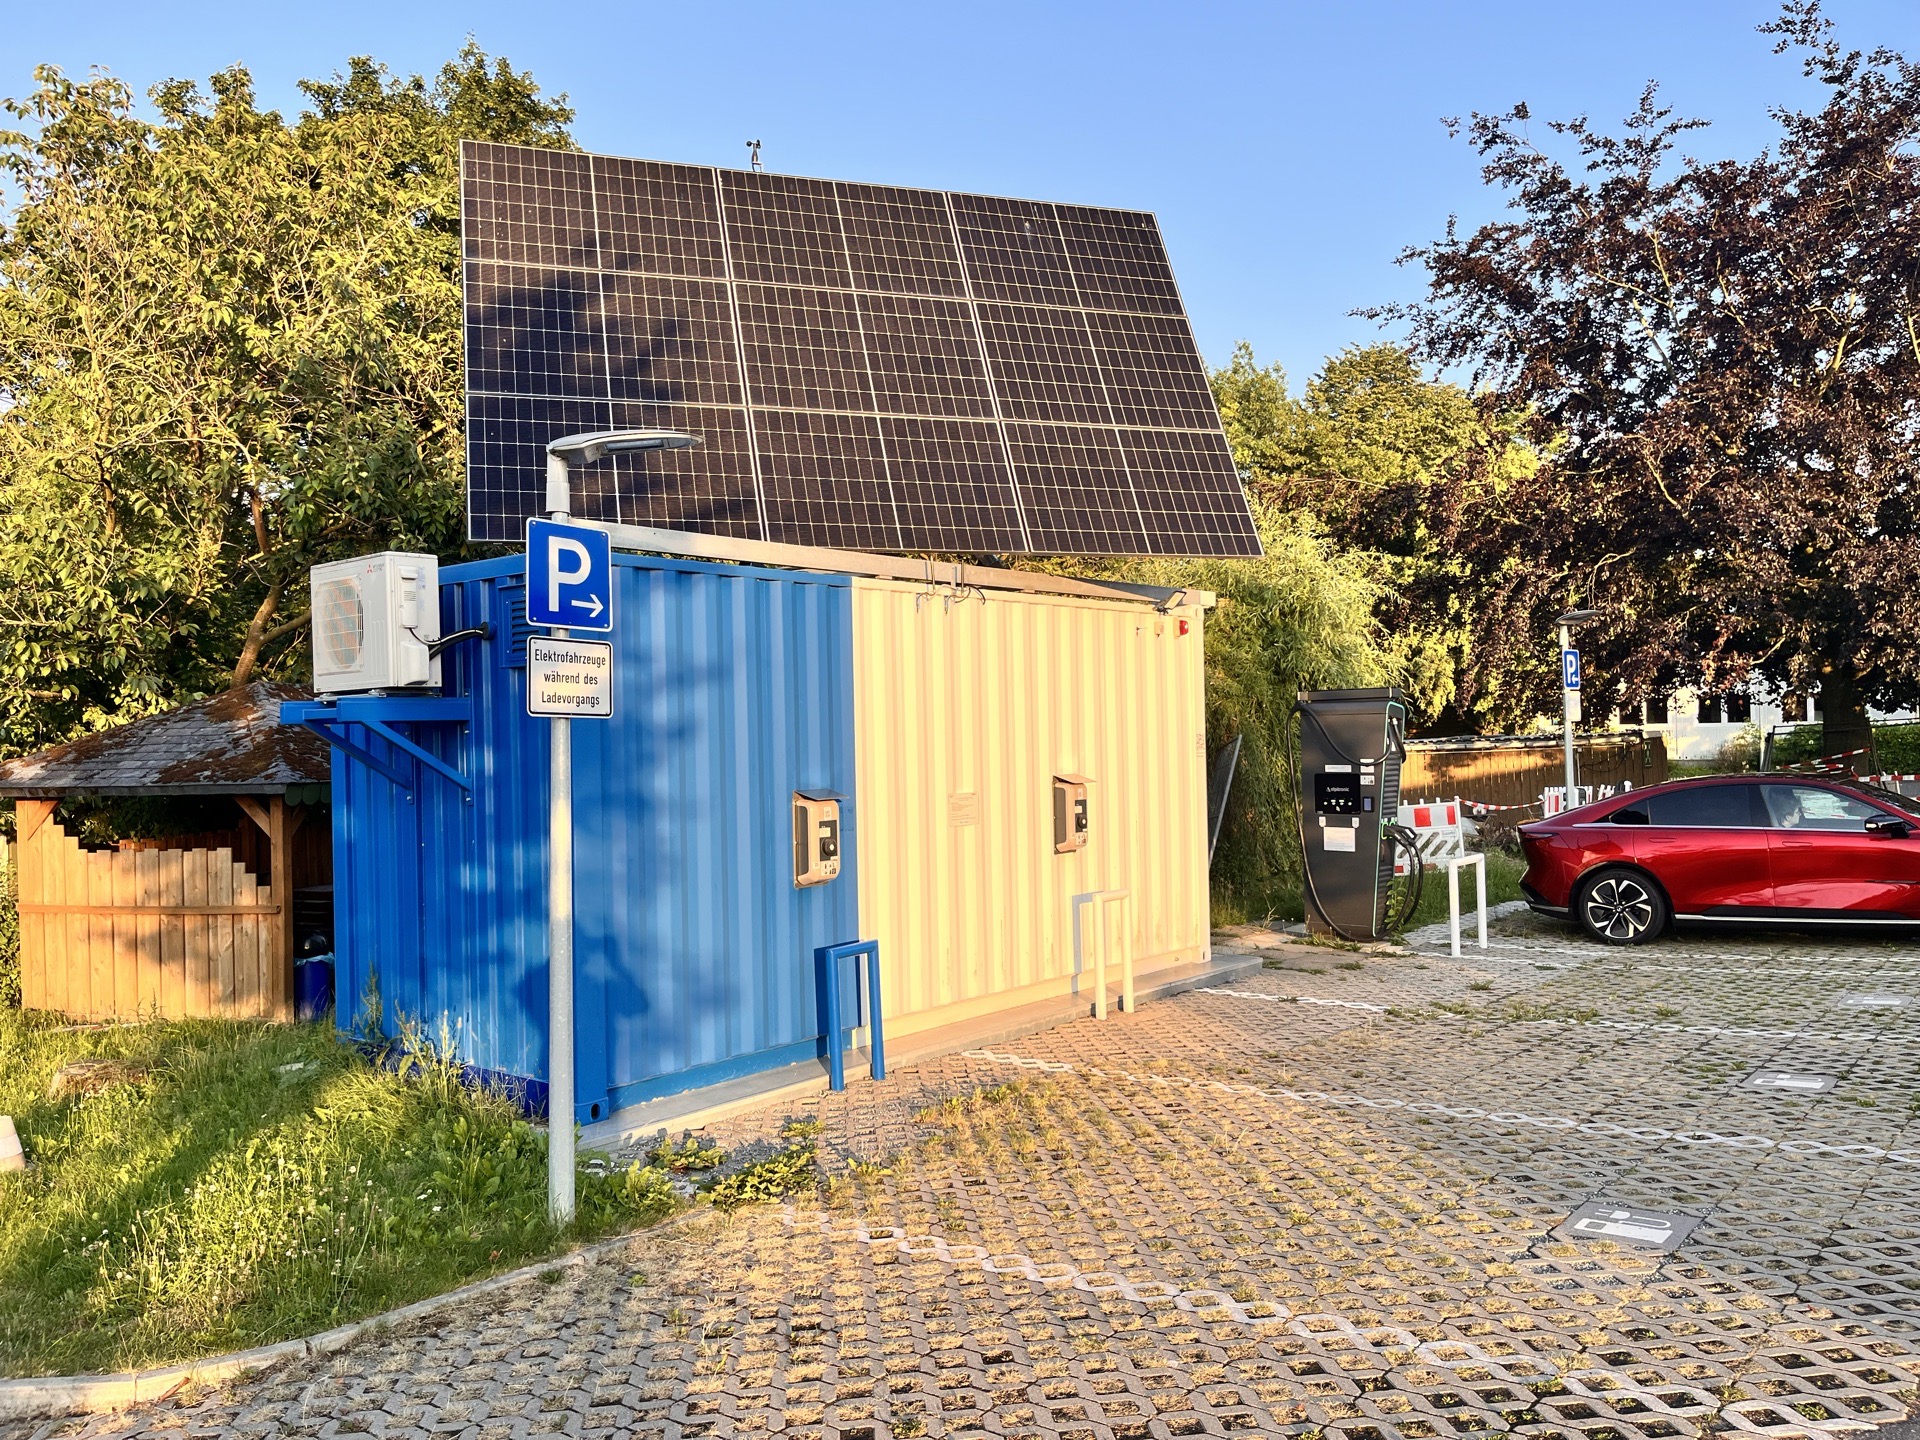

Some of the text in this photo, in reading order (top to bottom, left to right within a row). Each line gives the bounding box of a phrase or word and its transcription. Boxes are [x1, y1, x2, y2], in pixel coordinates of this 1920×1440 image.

[549, 536, 591, 612] P
[535, 649, 606, 668] Elektrofahrzeuge
[544, 671, 598, 685] während des
[1566, 654, 1576, 684] P
[541, 691, 600, 708] Ladevorgangs
